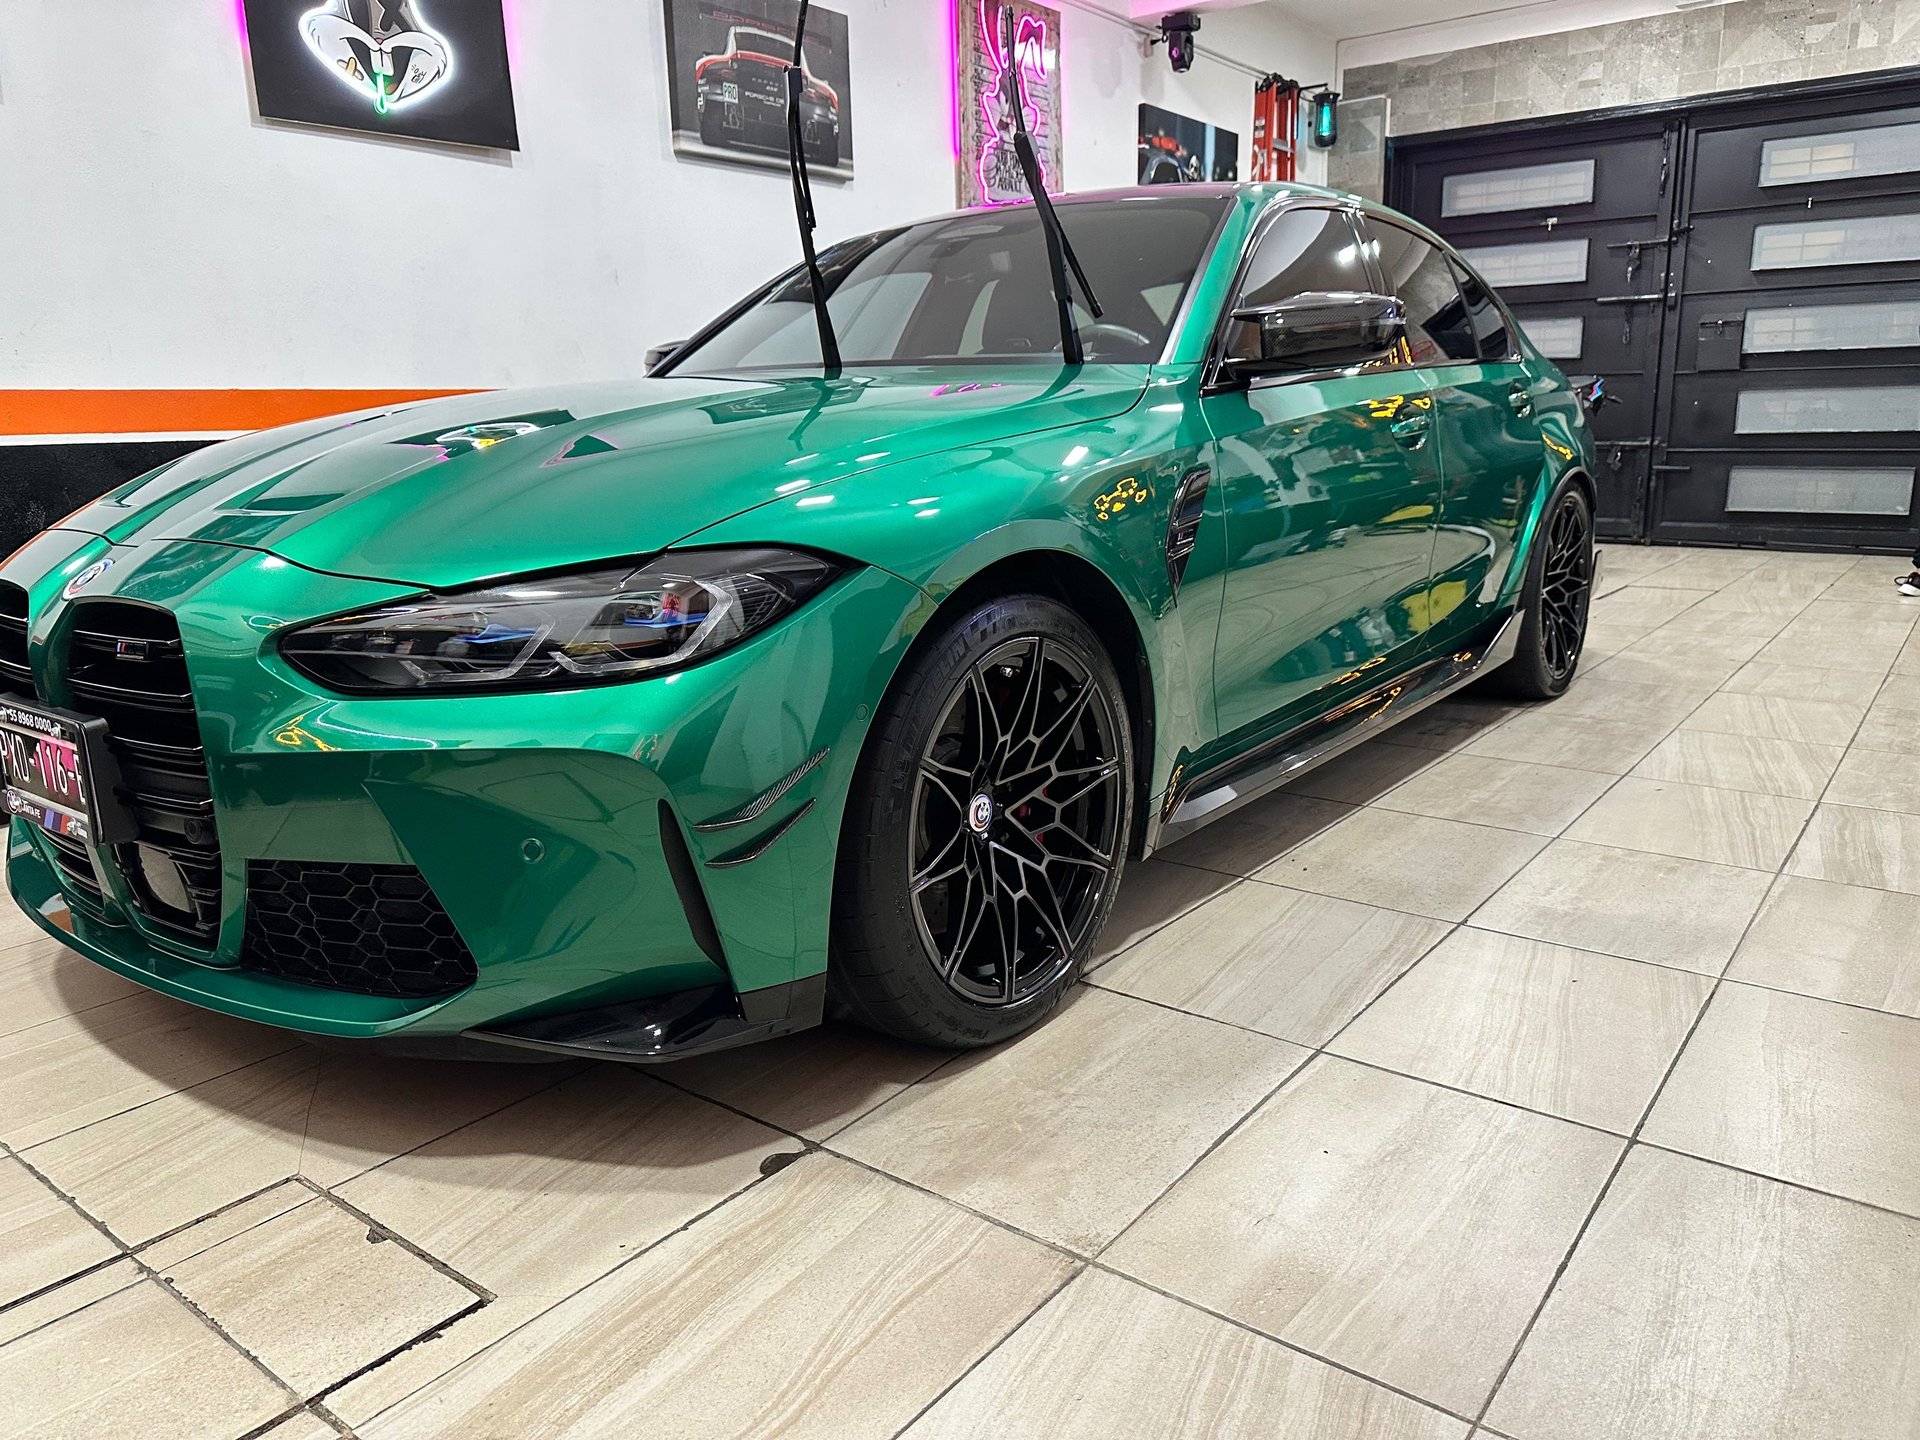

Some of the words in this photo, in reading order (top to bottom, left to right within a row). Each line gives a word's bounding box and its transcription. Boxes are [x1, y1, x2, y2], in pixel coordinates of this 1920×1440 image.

[724, 84, 737, 100] PRO
[18, 710, 34, 729] 8968
[34, 714, 51, 732] 0000
